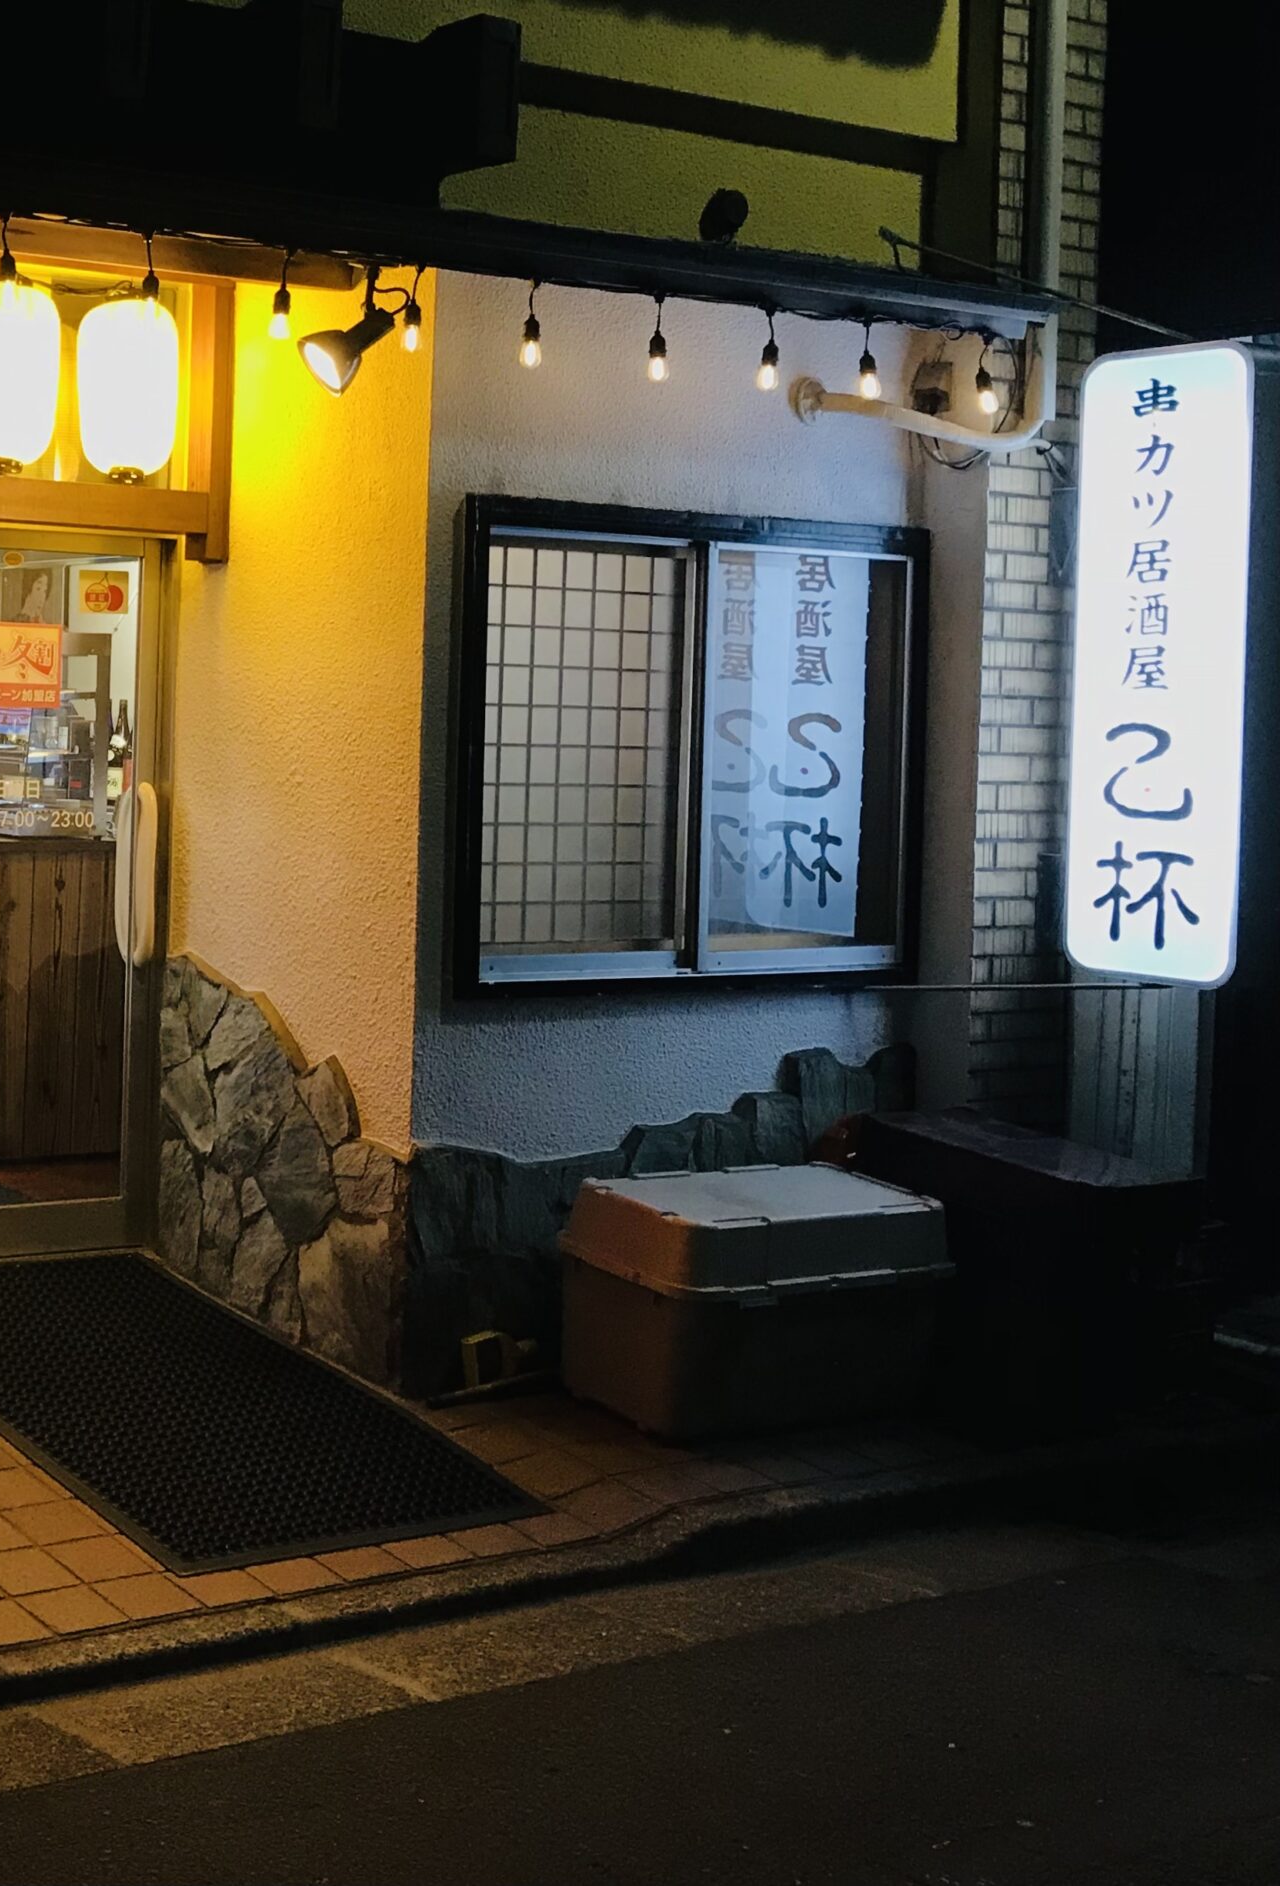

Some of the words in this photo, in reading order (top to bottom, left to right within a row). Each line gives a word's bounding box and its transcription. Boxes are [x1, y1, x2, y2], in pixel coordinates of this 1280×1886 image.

[1122, 378, 1179, 690] 串カツ居酒屋
